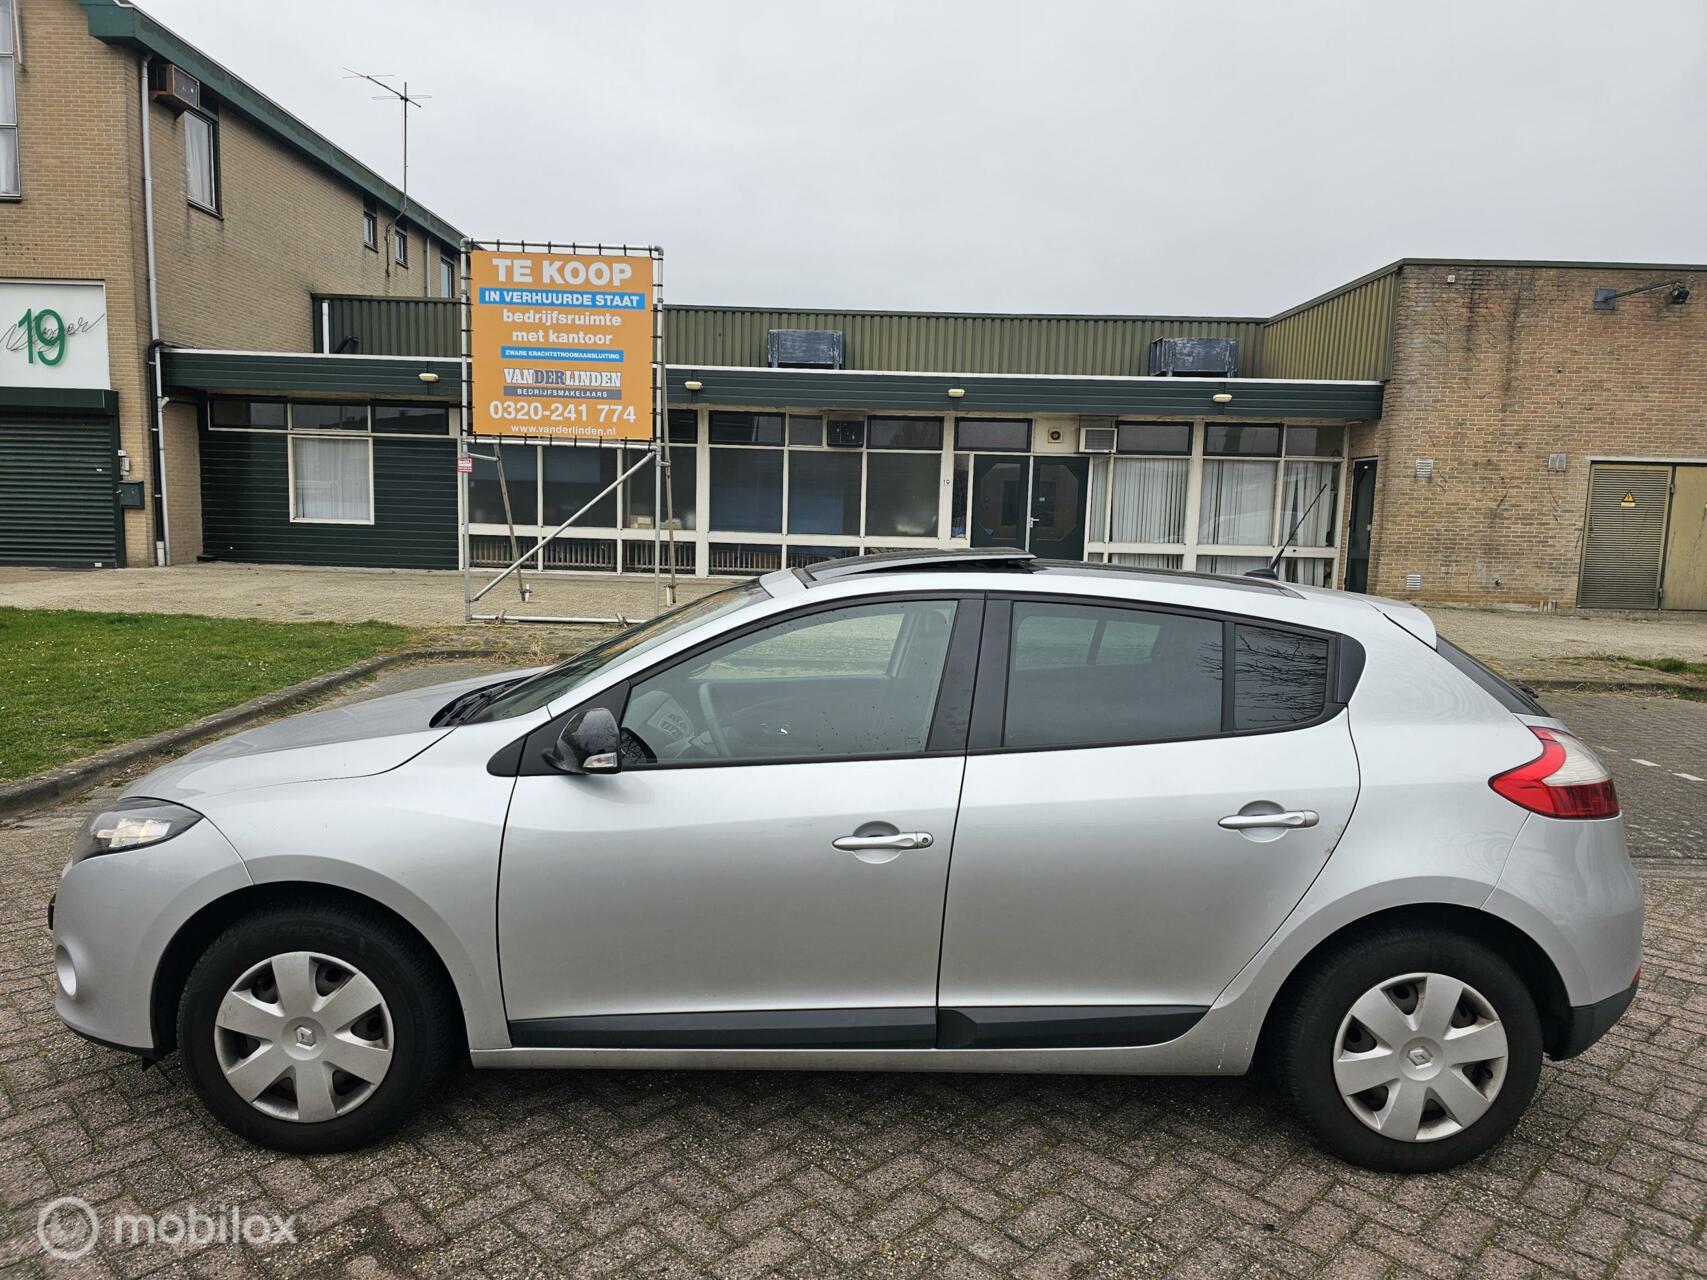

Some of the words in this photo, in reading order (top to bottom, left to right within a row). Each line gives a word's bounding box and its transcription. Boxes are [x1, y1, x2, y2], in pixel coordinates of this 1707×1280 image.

[492, 258, 533, 283] TE
[542, 260, 632, 287] KOOP
[485, 290, 500, 303] IN
[503, 291, 592, 305] VERHUURDE
[595, 294, 640, 307] STAAT
[503, 309, 622, 326] bedrijfsruimte
[18, 308, 66, 366] 19
[512, 330, 544, 342] met
[548, 330, 613, 345] kantoor
[505, 349, 528, 357] ZWARE
[517, 388, 608, 398] BEDRIJFSMAKELAARS
[489, 400, 587, 422] 0320-241
[597, 405, 637, 423] 774
[511, 424, 616, 436] www.vanderlinden.nl
